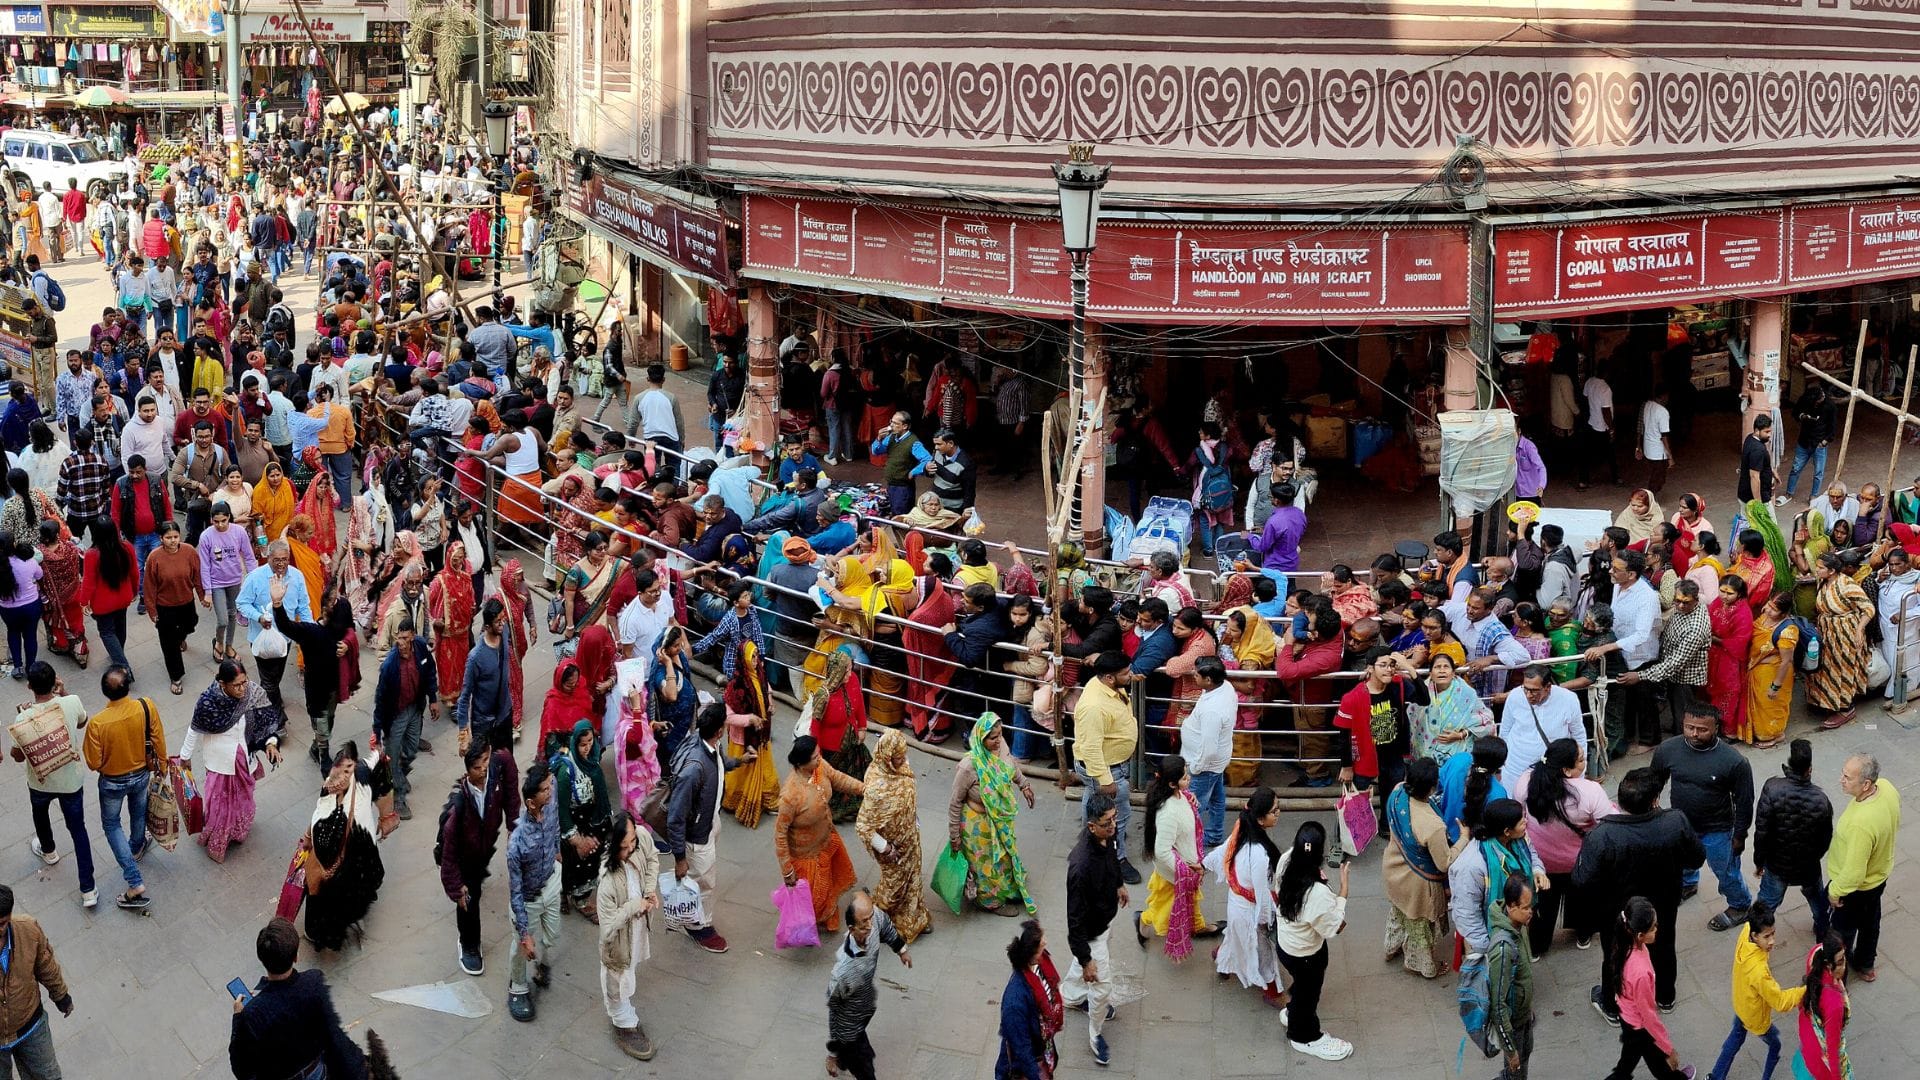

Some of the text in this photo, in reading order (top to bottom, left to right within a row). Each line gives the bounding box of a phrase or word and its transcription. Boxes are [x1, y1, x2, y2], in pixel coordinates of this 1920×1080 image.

[17, 12, 41, 24] safari
[641, 219, 668, 247] SILKS
[802, 230, 849, 243] MATCHING HOUSE
[1895, 229, 1920, 242] HANDL
[1574, 235, 1623, 255] गोपाल
[985, 251, 1006, 262] STORE
[1566, 258, 1606, 277] GOPAL
[1191, 270, 1256, 284] HANDLOOM
[1262, 271, 1287, 284] AND
[1405, 273, 1442, 281] SHOWROOM
[24, 729, 69, 755] Shree Gopa
